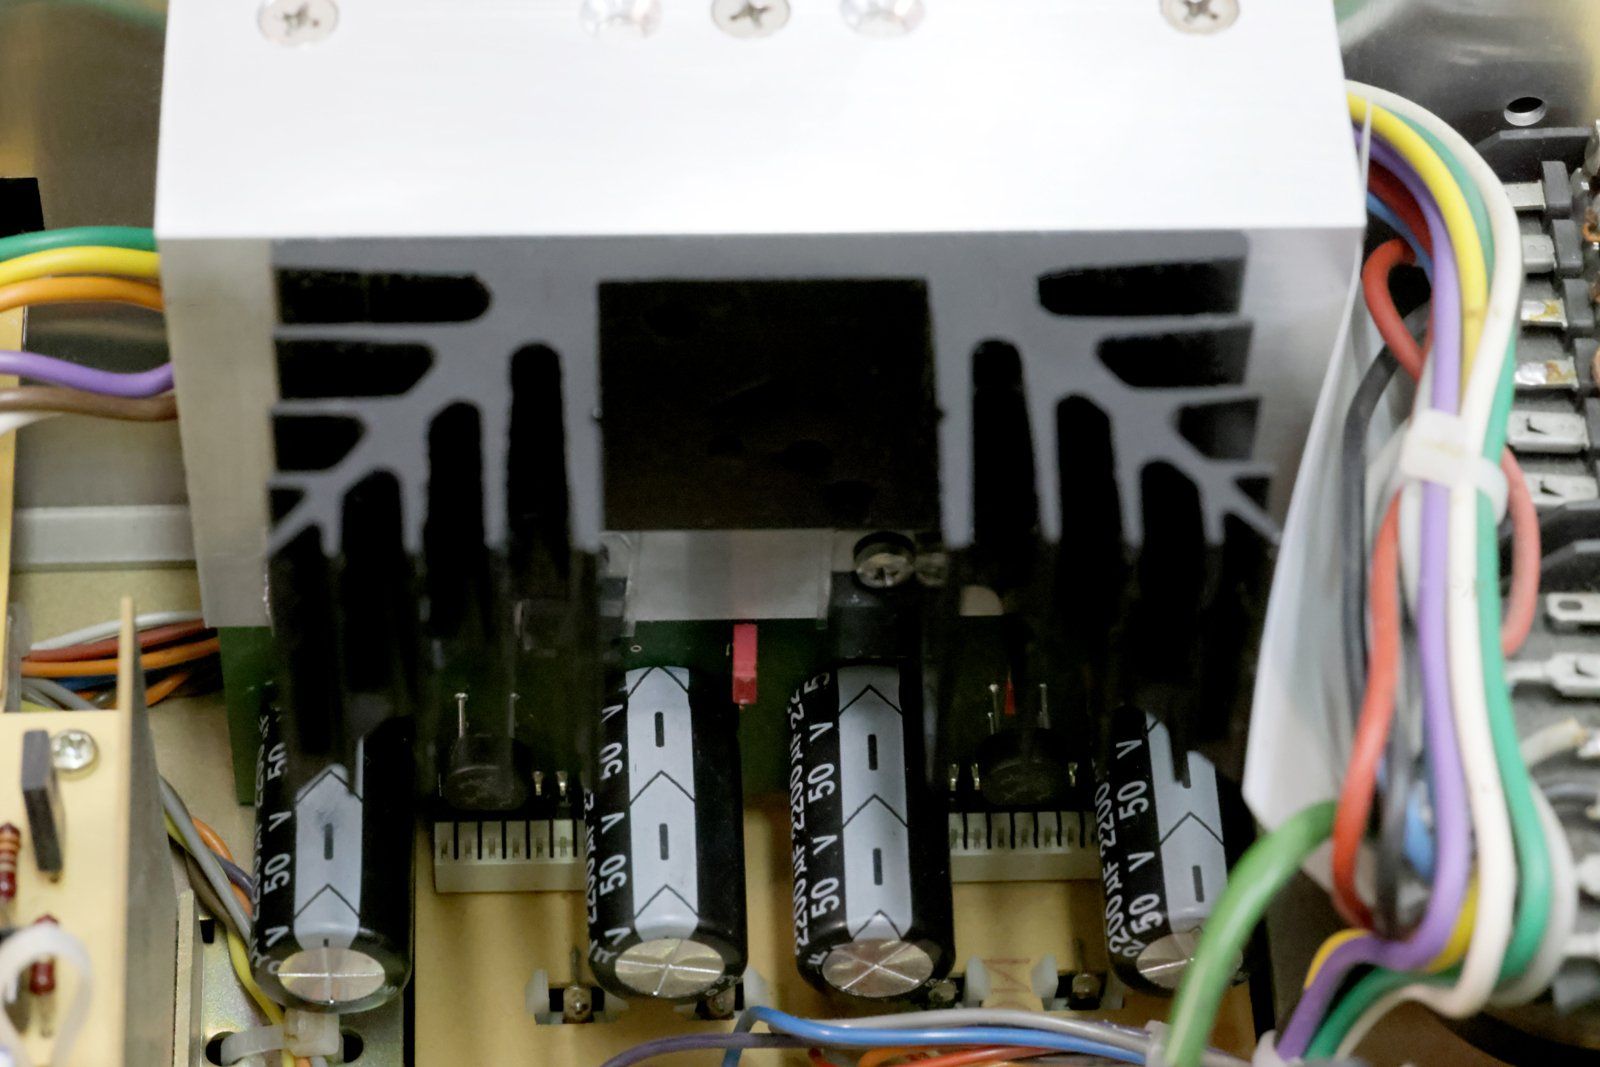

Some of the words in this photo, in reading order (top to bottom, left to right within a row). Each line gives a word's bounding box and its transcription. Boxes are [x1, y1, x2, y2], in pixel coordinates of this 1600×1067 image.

[600, 703, 624, 724] V
[808, 720, 834, 743] V
[1115, 738, 1143, 761] V
[807, 761, 836, 804] 50
[1116, 779, 1150, 821] 50
[789, 763, 806, 841] 2200
[1094, 781, 1118, 858] 2200
[268, 810, 293, 833] V
[600, 811, 625, 834] V
[812, 834, 838, 856] V
[1126, 851, 1156, 873] V
[263, 852, 292, 895] 50
[599, 853, 628, 897] 50
[1102, 861, 1124, 895] µF
[793, 877, 810, 956] 2200
[810, 876, 841, 919] 50
[1128, 892, 1164, 935] 50
[264, 925, 290, 948] V
[603, 926, 632, 947] V
[1105, 894, 1147, 958] 2200
